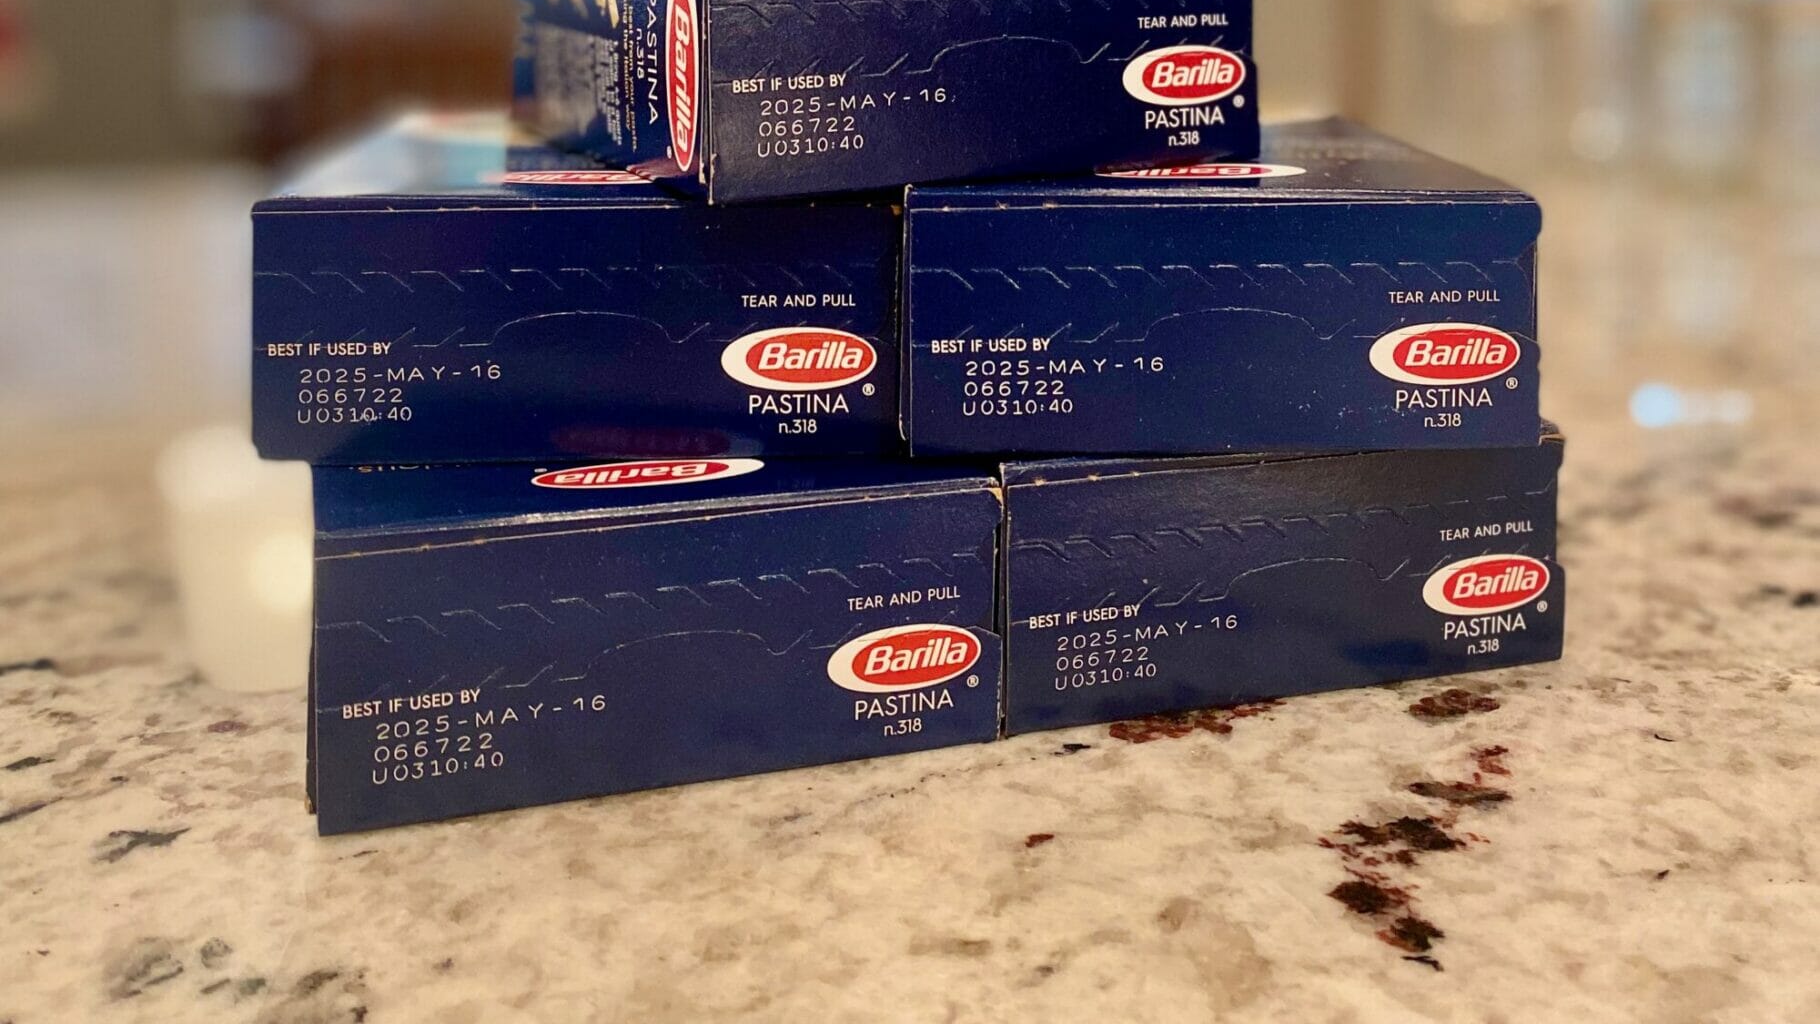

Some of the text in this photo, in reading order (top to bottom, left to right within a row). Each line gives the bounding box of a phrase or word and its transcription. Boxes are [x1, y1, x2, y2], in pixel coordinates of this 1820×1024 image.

[1137, 13, 1229, 29] TEAR AND PULL
[636, 28, 644, 79] n.318
[675, 4, 691, 152] Barilla
[732, 73, 846, 93] BEST IF USED BY
[1151, 58, 1235, 88] Barilla
[759, 116, 855, 137] 066722
[1145, 106, 1225, 129] PASTINA
[1168, 131, 1200, 146] n.318
[741, 294, 856, 308] TEAR AND PULL
[1388, 289, 1500, 304] TEAR AND PULL
[267, 341, 392, 356] BEST IF USED BY
[758, 341, 864, 370] Barilla
[931, 337, 1051, 354] BEST IF USED BY
[1404, 337, 1507, 367] Barilla
[298, 387, 403, 404] 066722
[964, 379, 1065, 397] 066722
[1395, 387, 1494, 409] PASTINA
[748, 393, 850, 415] PASTINA
[778, 419, 818, 434] n.318
[1424, 413, 1462, 428] n.318
[553, 463, 708, 485] Barilla
[1440, 520, 1533, 542] TEAR AND PULL
[1452, 565, 1539, 600] Barilla
[847, 585, 961, 612] TEAR AND PULL
[1028, 603, 1141, 630] BEST IF USED BY
[1443, 612, 1527, 641] PASTINA
[863, 636, 968, 676] Barilla
[1467, 638, 1500, 655] n.318
[1056, 646, 1149, 672] 066722
[342, 687, 481, 720] BEST IF USED BY
[854, 688, 954, 721] PASTINA
[883, 717, 922, 737] n.318
[373, 732, 493, 763] 066722
